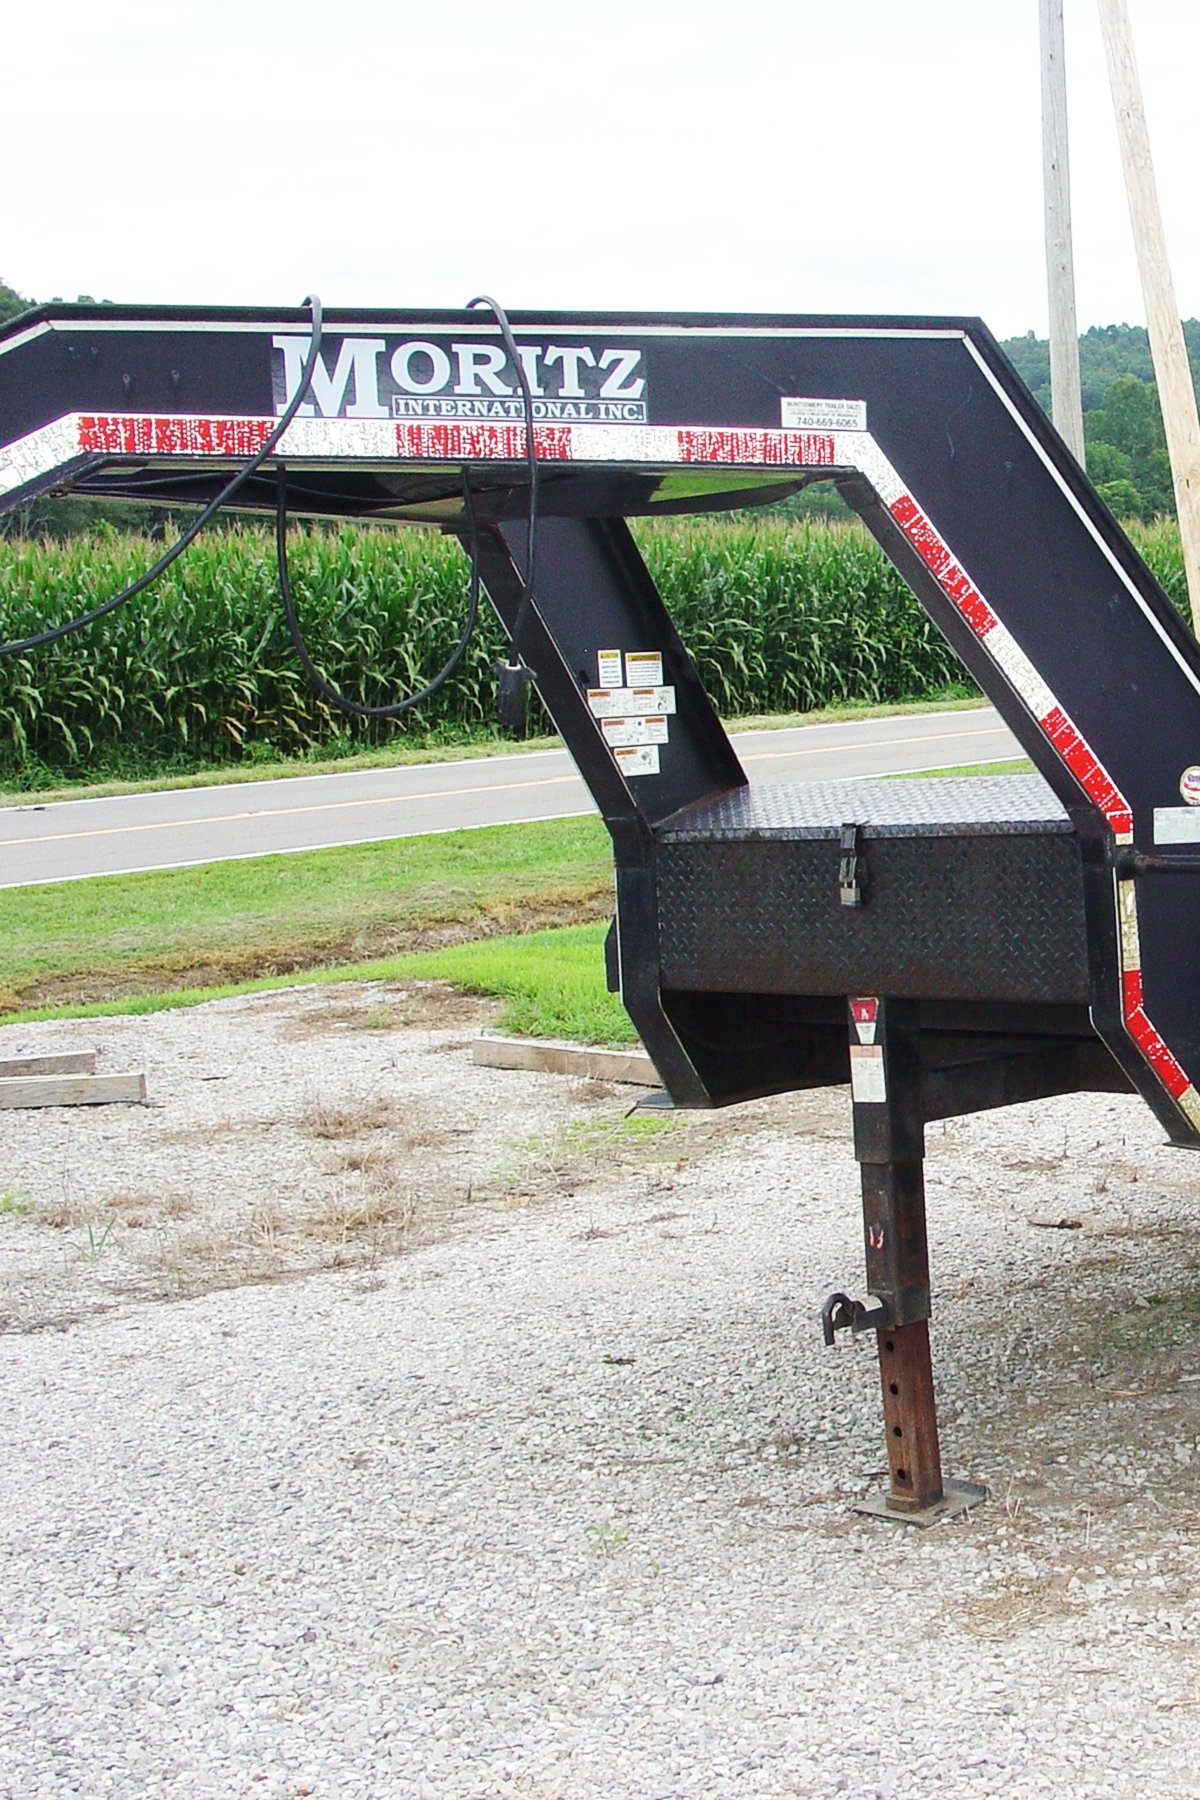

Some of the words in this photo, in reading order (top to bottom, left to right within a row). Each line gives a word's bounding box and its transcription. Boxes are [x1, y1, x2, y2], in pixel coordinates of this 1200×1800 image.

[272, 335, 645, 417] MORITZ
[397, 400, 593, 418] INTERNATIONAL
[598, 403, 643, 420] INC.
